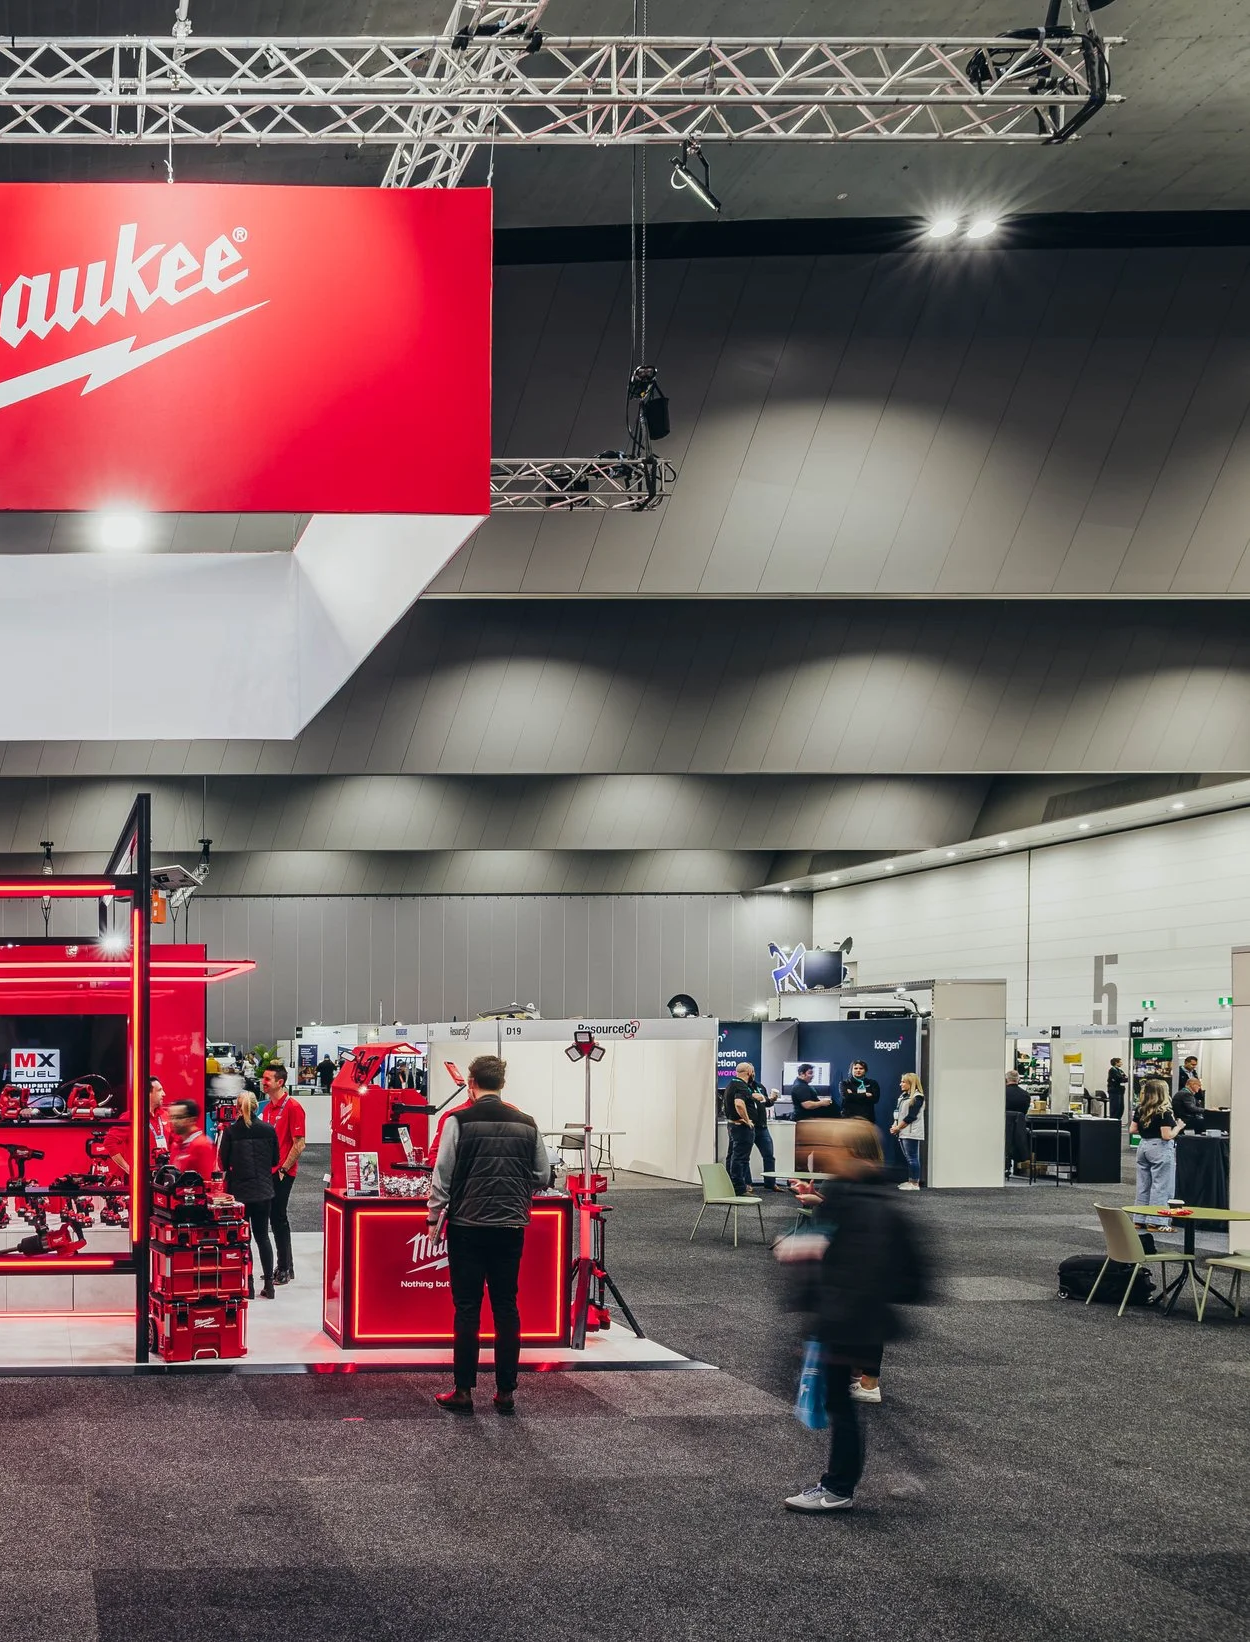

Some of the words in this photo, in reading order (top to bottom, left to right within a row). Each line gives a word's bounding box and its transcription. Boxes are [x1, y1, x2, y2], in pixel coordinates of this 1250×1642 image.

[1093, 954, 1119, 1025] 5
[506, 1027, 521, 1035] D19
[14, 1053, 55, 1068] MX
